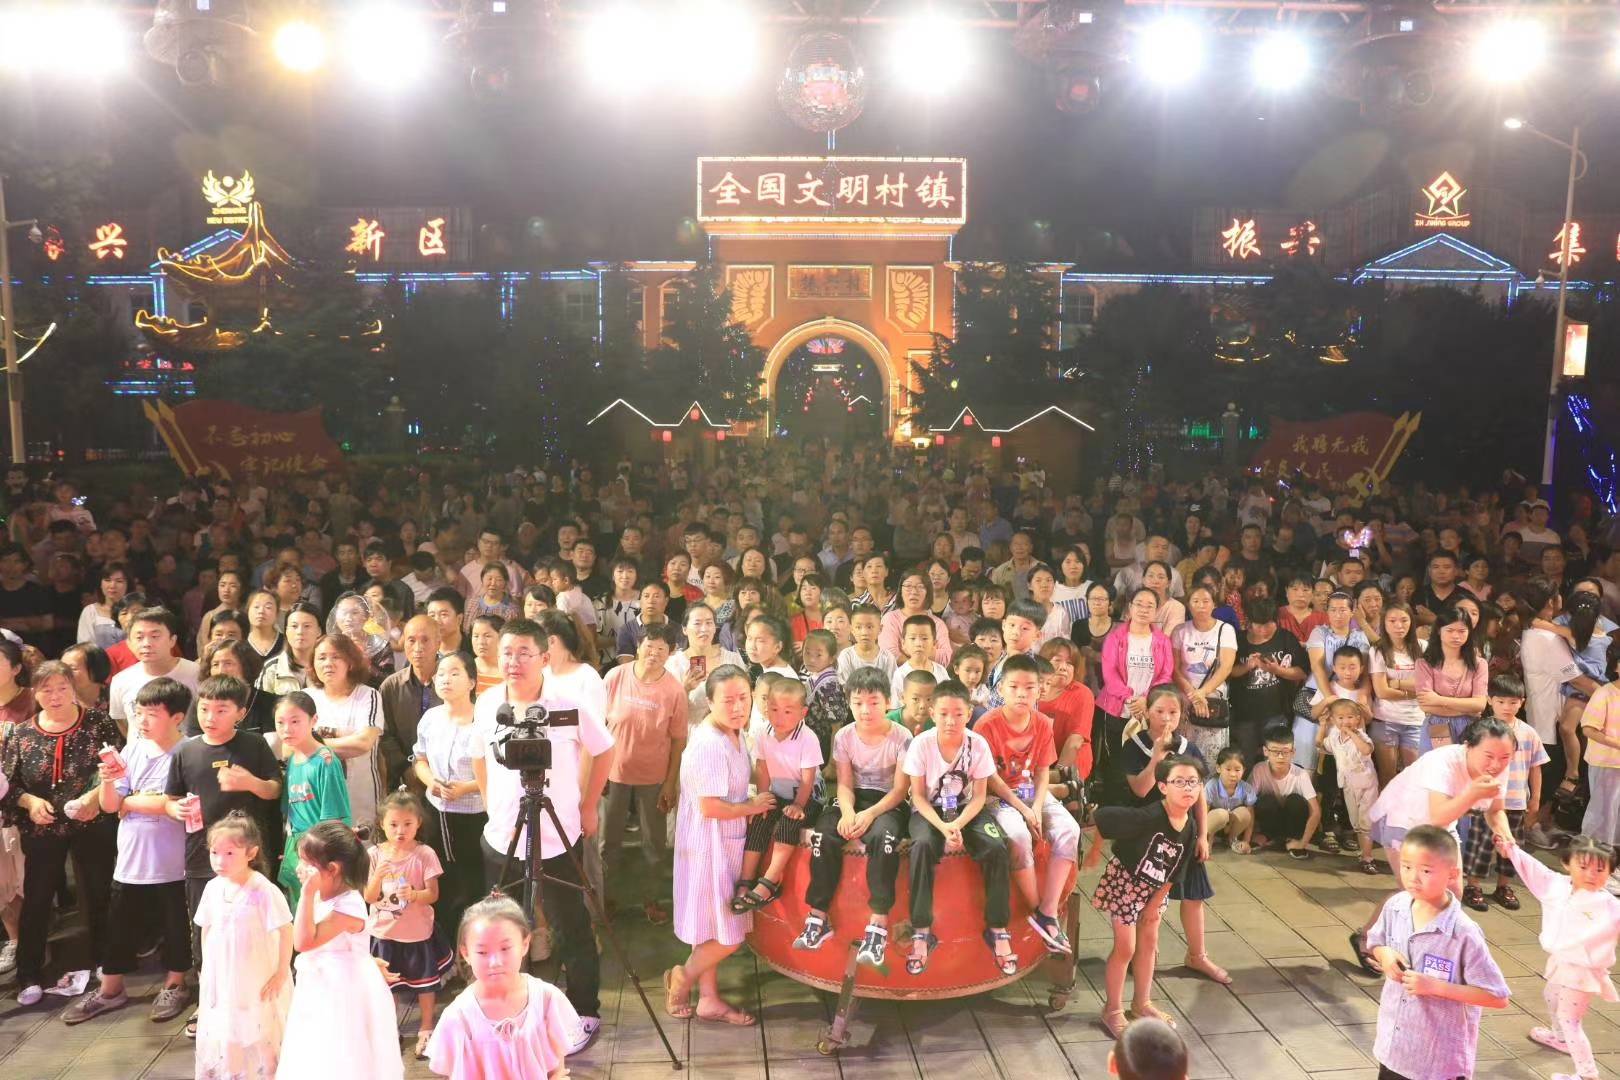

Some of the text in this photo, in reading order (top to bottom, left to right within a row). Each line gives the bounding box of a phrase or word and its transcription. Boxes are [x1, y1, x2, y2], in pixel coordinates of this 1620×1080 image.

[709, 171, 956, 209] 全国文明村镇
[345, 218, 447, 262] 新区
[1221, 218, 1320, 259] 振兴
[207, 424, 296, 447] 不忘初心
[1425, 959, 1451, 972] PASS
